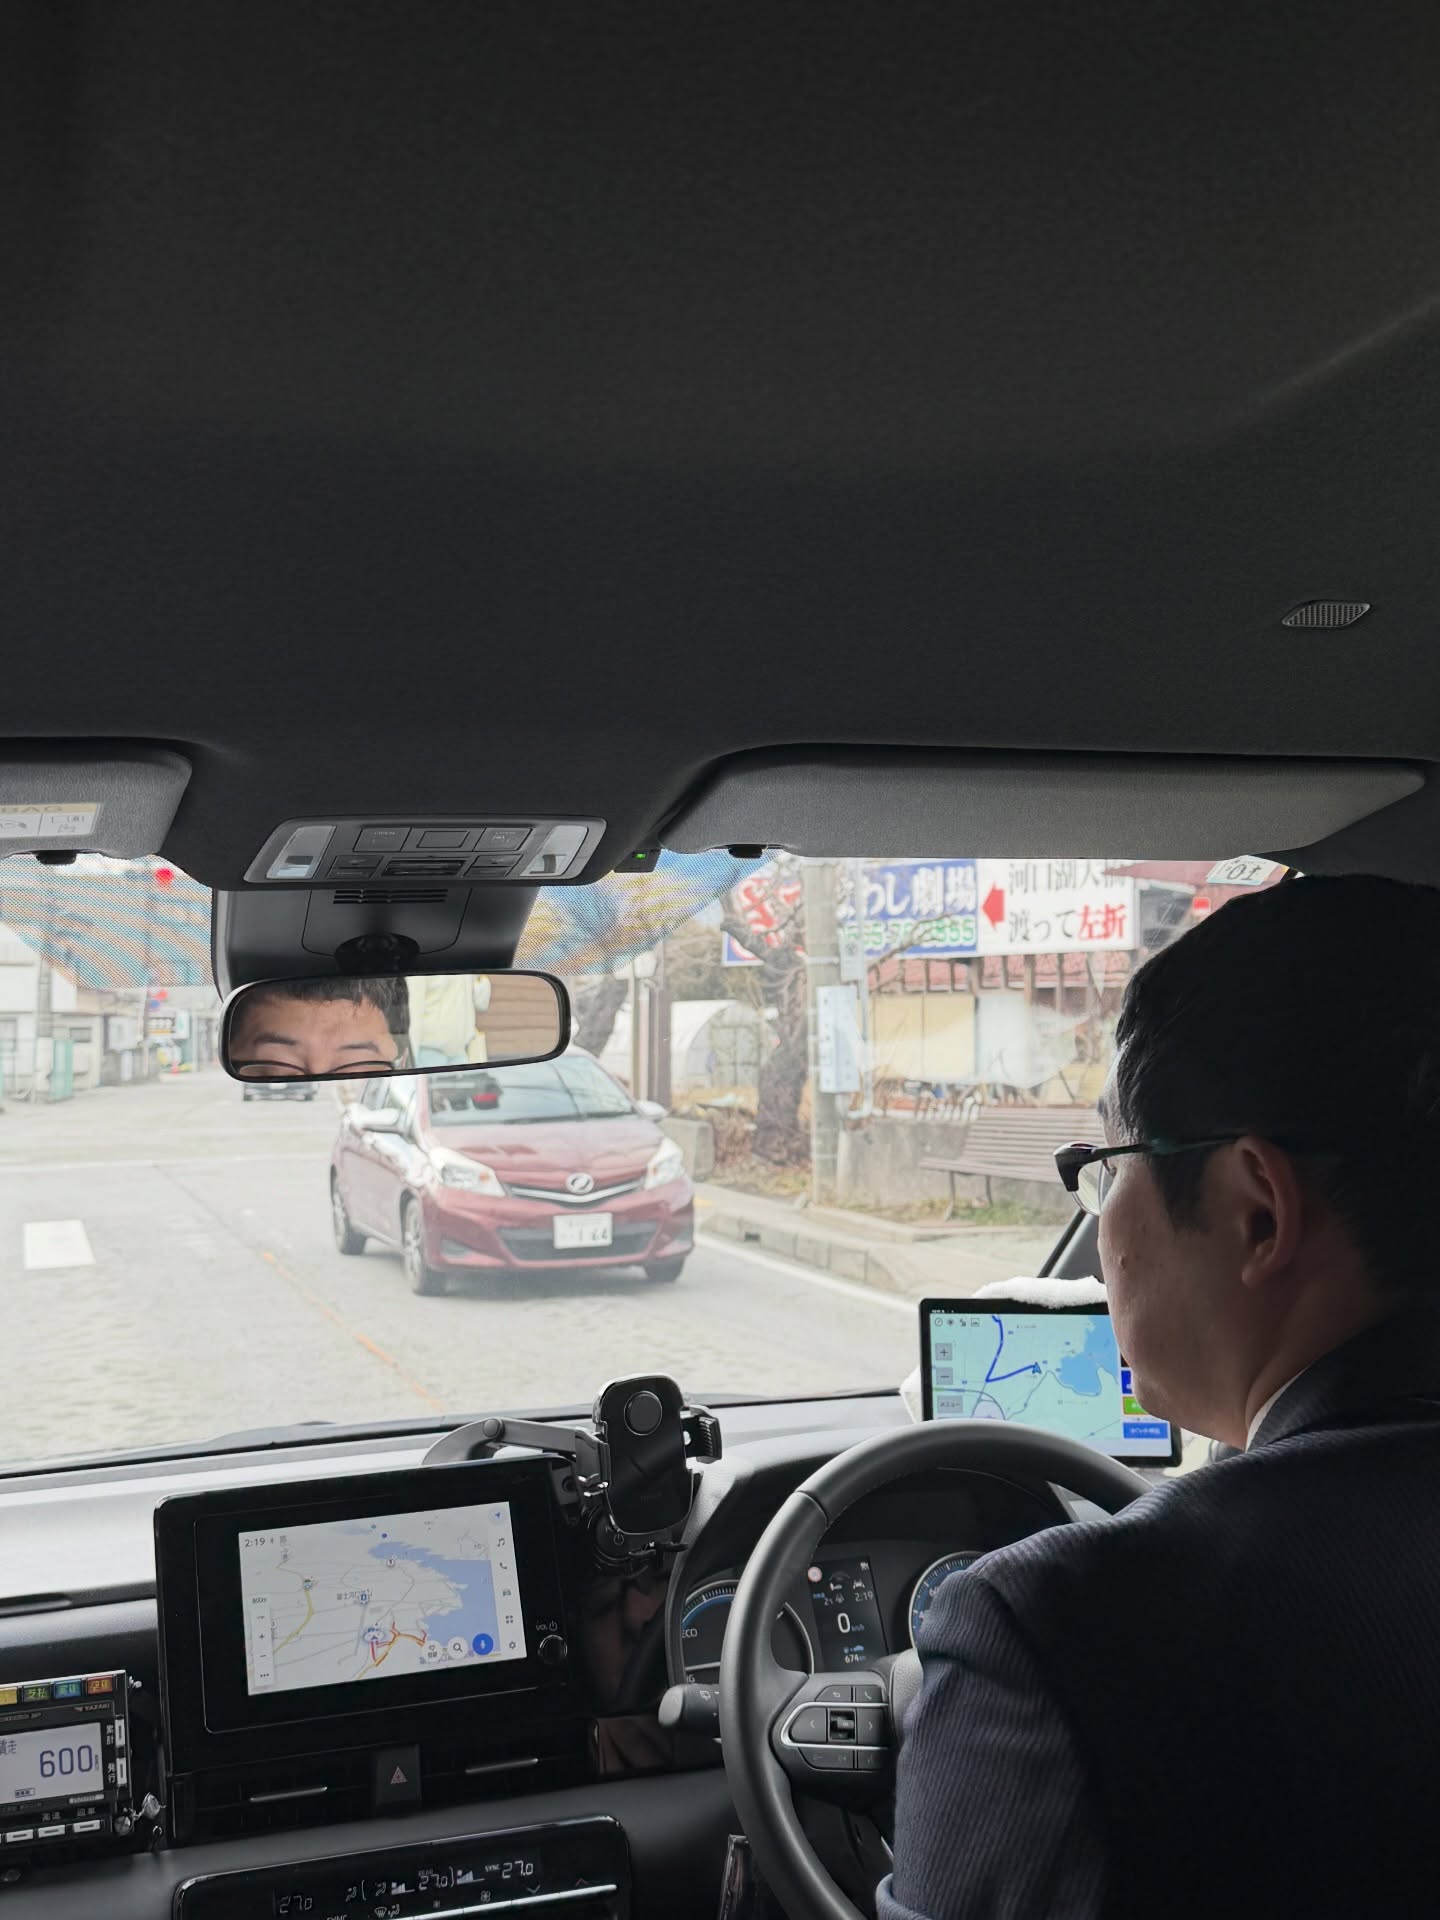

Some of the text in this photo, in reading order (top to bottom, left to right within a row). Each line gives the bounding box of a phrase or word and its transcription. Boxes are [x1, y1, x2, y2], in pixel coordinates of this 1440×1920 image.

[1009, 904, 1126, 943] 渡って左折
[244, 1537, 266, 1548] 2:19
[854, 1591, 874, 1602] 2:19
[837, 1613, 851, 1633] 0
[844, 1654, 859, 1664] 674
[84, 1703, 110, 1713] YAZAKI
[40, 1745, 93, 1778] 600
[501, 1860, 534, 1880] 27.0
